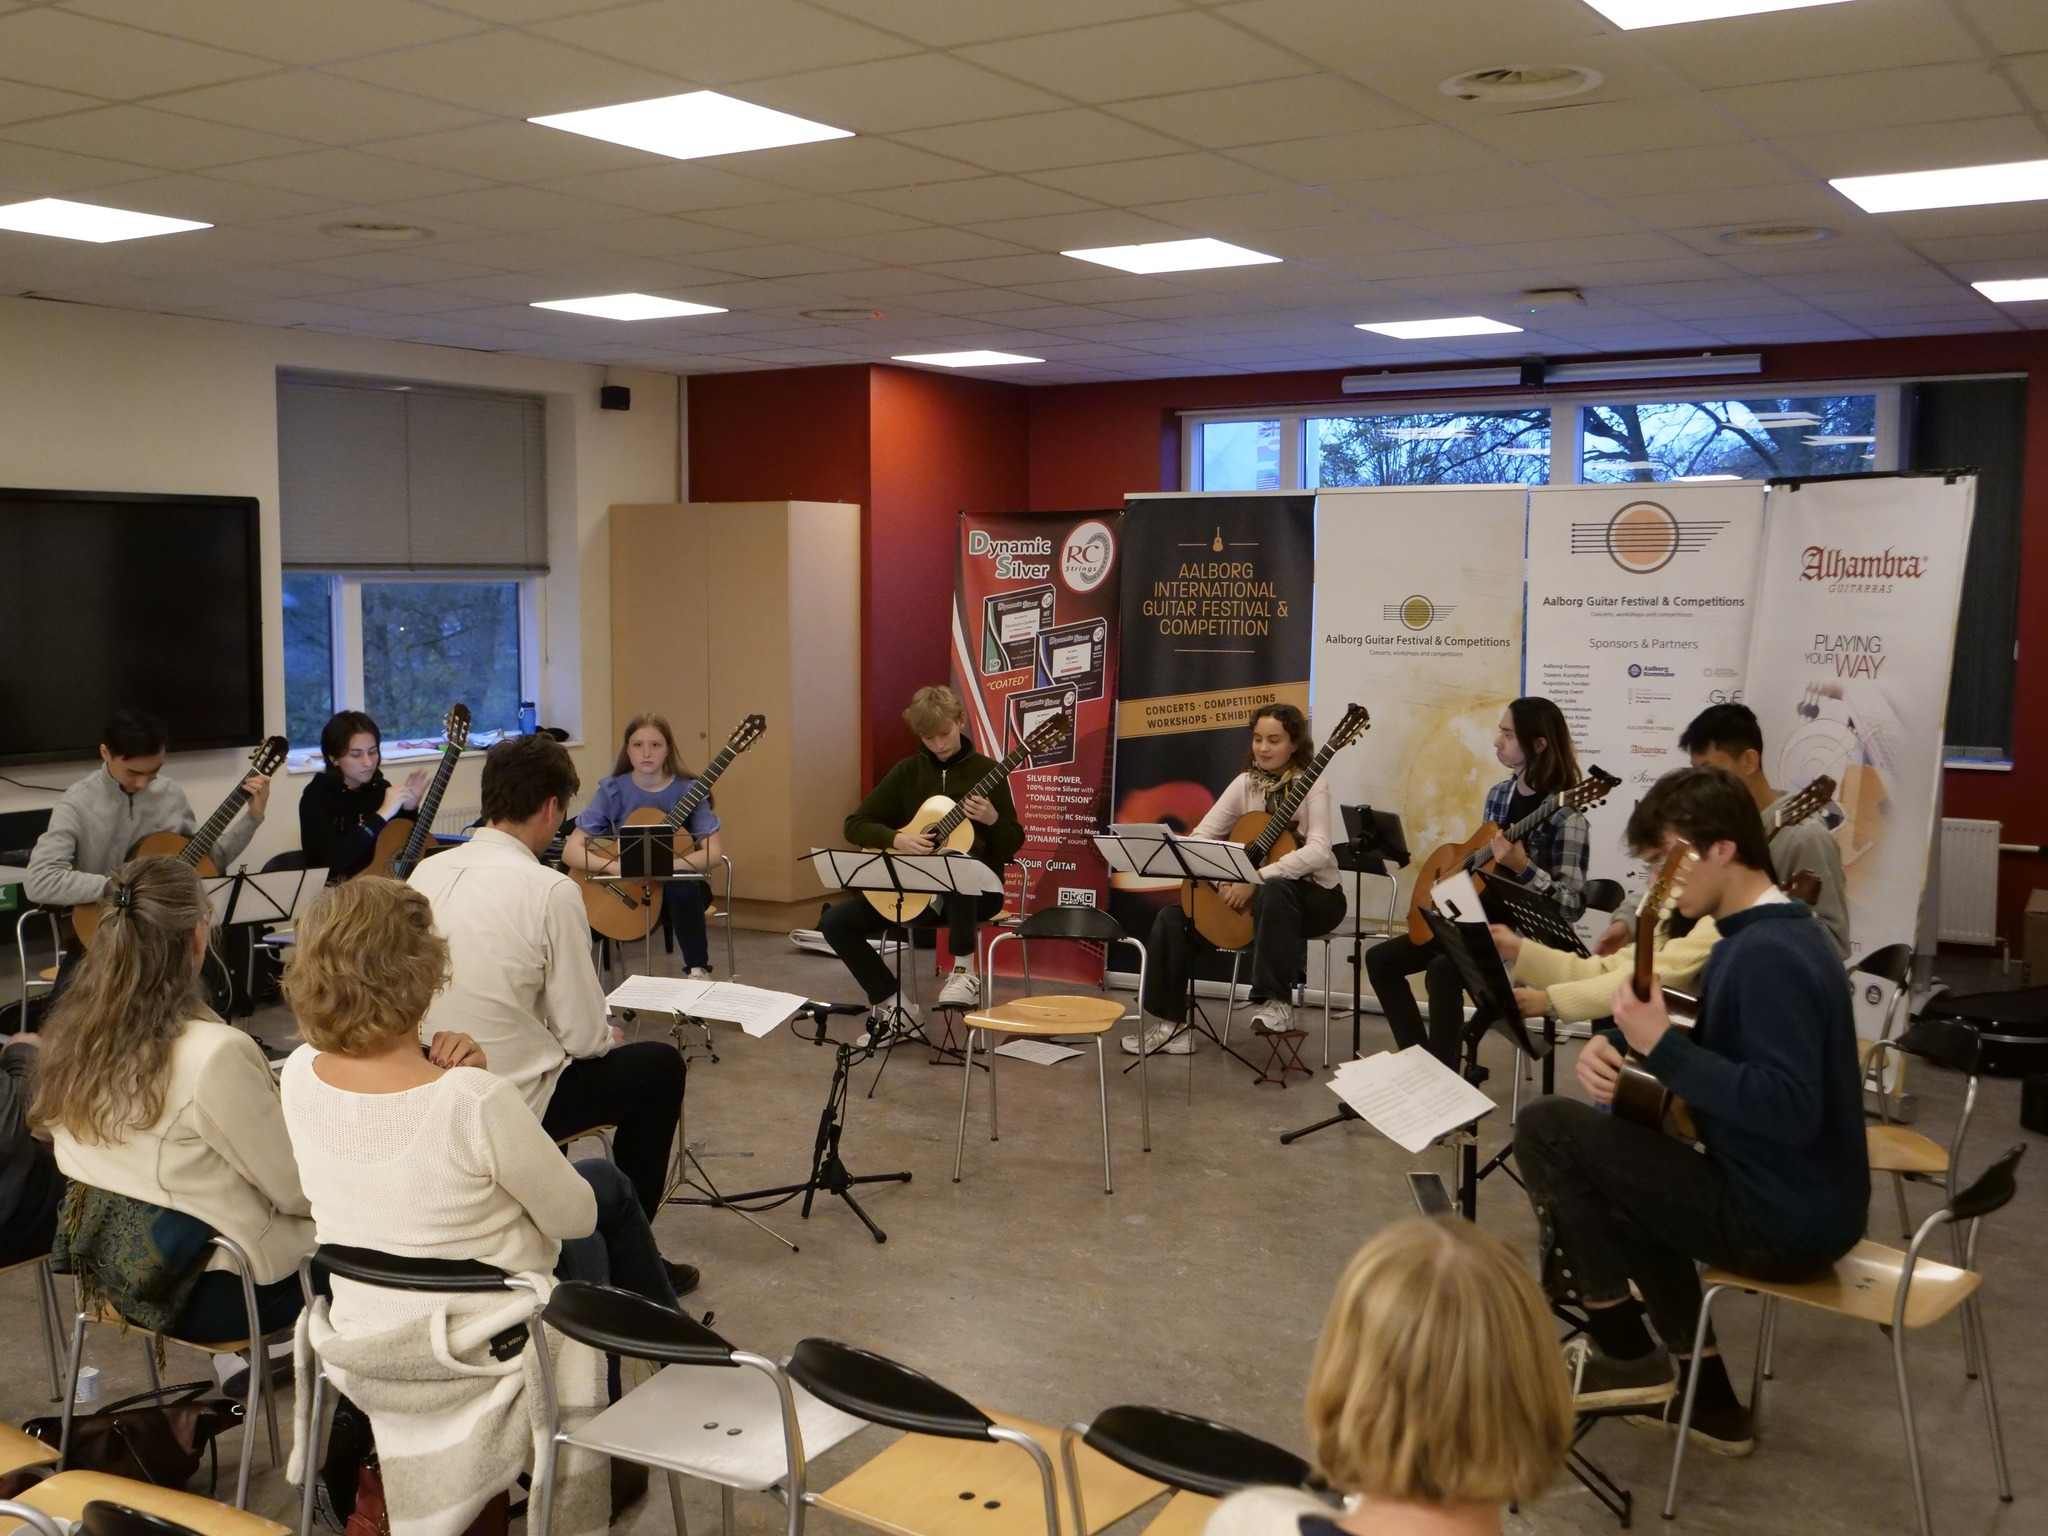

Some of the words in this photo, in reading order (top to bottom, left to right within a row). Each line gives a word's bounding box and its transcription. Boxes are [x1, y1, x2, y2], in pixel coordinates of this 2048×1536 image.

[969, 531, 1051, 559] Dynamic
[1066, 545, 1100, 565] RC
[996, 555, 1050, 580] Silver
[1178, 563, 1254, 579] AALBORG
[1799, 545, 1927, 583] Alhambra
[1154, 581, 1277, 598] INTERNATIONAL
[1828, 584, 1893, 594] GUITARRAS
[1143, 600, 1197, 617] GUITAR
[1202, 600, 1271, 617] FESTIVAL
[1277, 601, 1288, 617] &
[1543, 596, 1583, 608] Aalborg
[1586, 596, 1618, 606] Guitar
[1621, 596, 1659, 606] Festival
[1661, 596, 1670, 606] &
[1673, 596, 1745, 608] Competitions
[1159, 619, 1268, 636] COMPETITION
[1325, 634, 1363, 646] Aalborg
[1365, 634, 1394, 645] Guitar
[1396, 635, 1433, 646] Festival
[1435, 636, 1442, 646] &
[1444, 636, 1511, 649] Competitions
[1589, 638, 1638, 650] Sponsors
[1641, 639, 1649, 649] &
[1652, 638, 1698, 649] Partners
[1814, 634, 1881, 653] PLAYING
[1804, 652, 1833, 664] YOUR
[1835, 654, 1885, 679] WAY
[1145, 702, 1196, 715] CONCERTS
[1204, 694, 1276, 709] COMPETITIONS
[1147, 714, 1207, 729] WORKSHOPS
[1215, 710, 1252, 722] EXHIBIT
[1026, 774, 1052, 783] SILVER
[1053, 776, 1082, 785] POWER,
[1062, 785, 1080, 793] Silver
[1081, 786, 1094, 794] with
[1025, 812, 1055, 820] developed
[1047, 826, 1071, 834] Elegant
[1046, 859, 1076, 871] GUITAR
